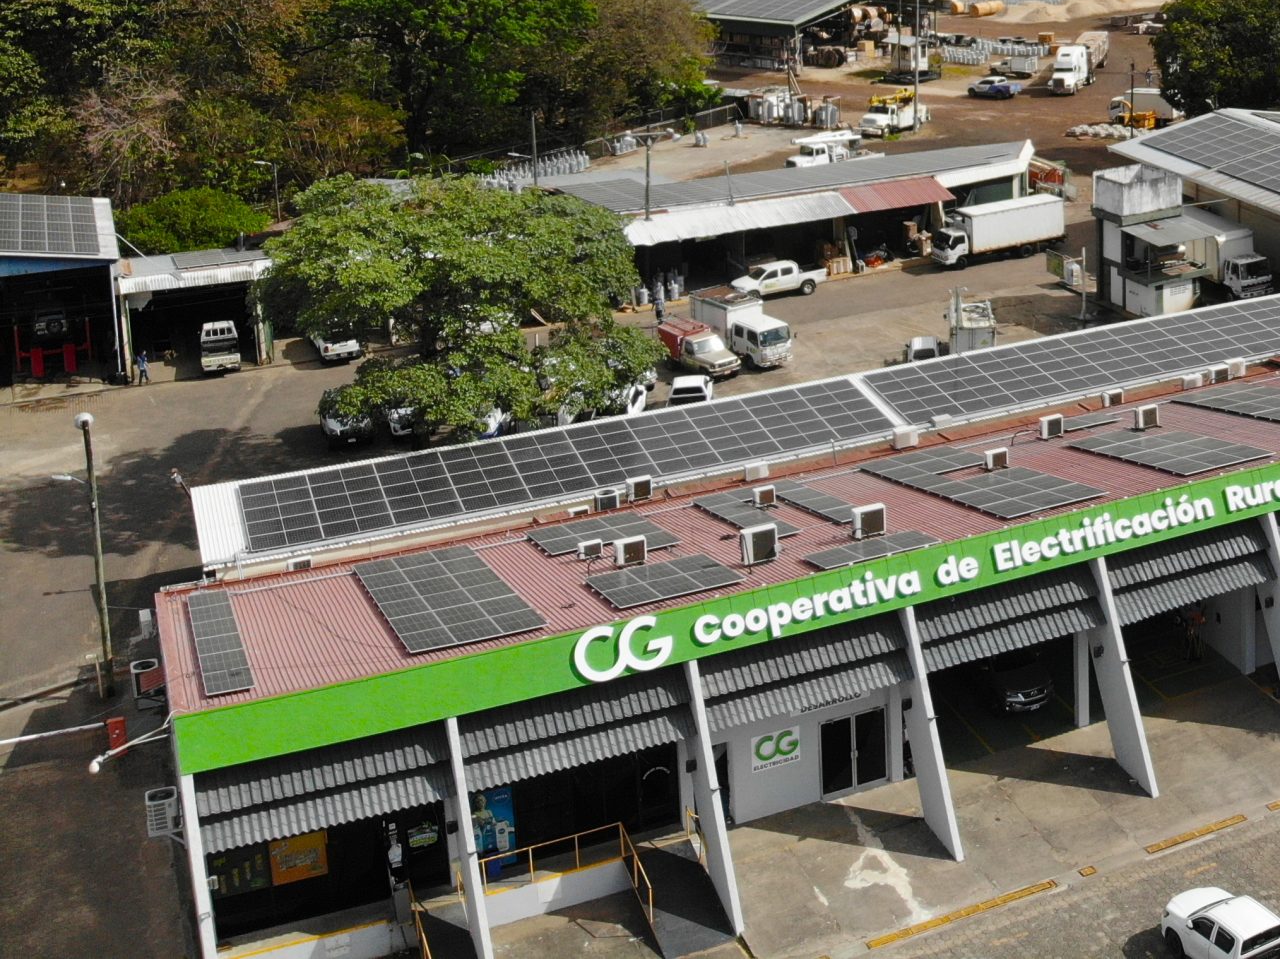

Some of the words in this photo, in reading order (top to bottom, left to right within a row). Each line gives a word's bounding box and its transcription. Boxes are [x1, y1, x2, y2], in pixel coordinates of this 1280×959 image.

[574, 616, 673, 681] CG
[694, 571, 922, 643] Cooperativa
[938, 555, 979, 584] de
[994, 494, 1216, 570] Electrificación
[755, 730, 799, 761] CG
[753, 754, 799, 772] ELECTRICIDAD
